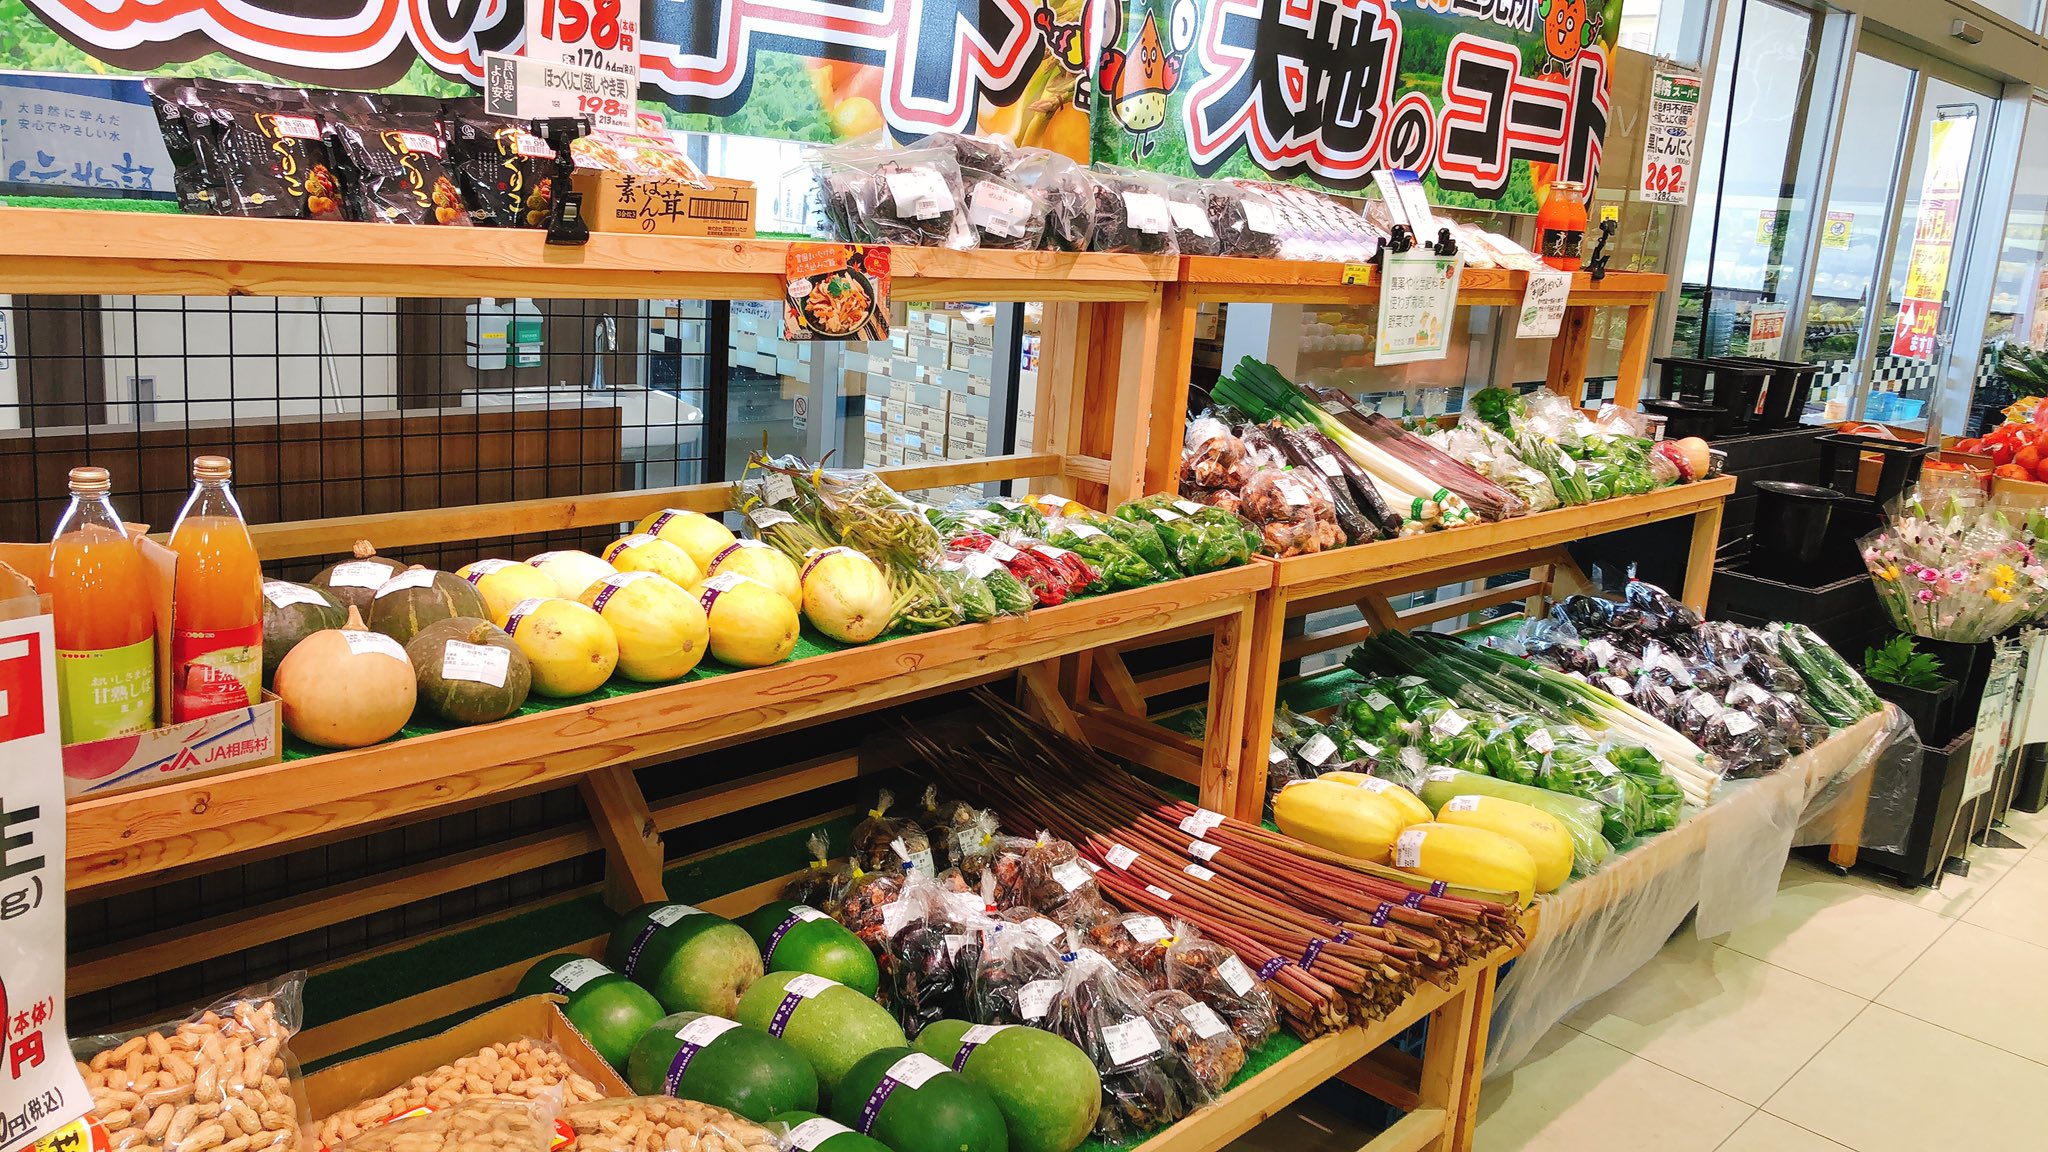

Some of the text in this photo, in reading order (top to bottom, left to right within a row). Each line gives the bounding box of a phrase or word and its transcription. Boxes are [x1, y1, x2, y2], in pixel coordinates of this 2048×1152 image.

[619, 34, 634, 52] 円
[491, 65, 503, 109] より安く
[503, 60, 514, 102] 良い品を
[545, 67, 629, 99] ほっくりこ(蒸しやき栗)
[18, 103, 121, 126] 大自然に学んだ
[577, 94, 620, 117] 198
[18, 118, 121, 142] 安心でやさしい水
[615, 175, 636, 203] 素
[1645, 162, 1682, 192] 262
[204, 736, 268, 763] JA相馬村
[6, 996, 54, 1041] (本体)
[9, 1031, 46, 1080] 円
